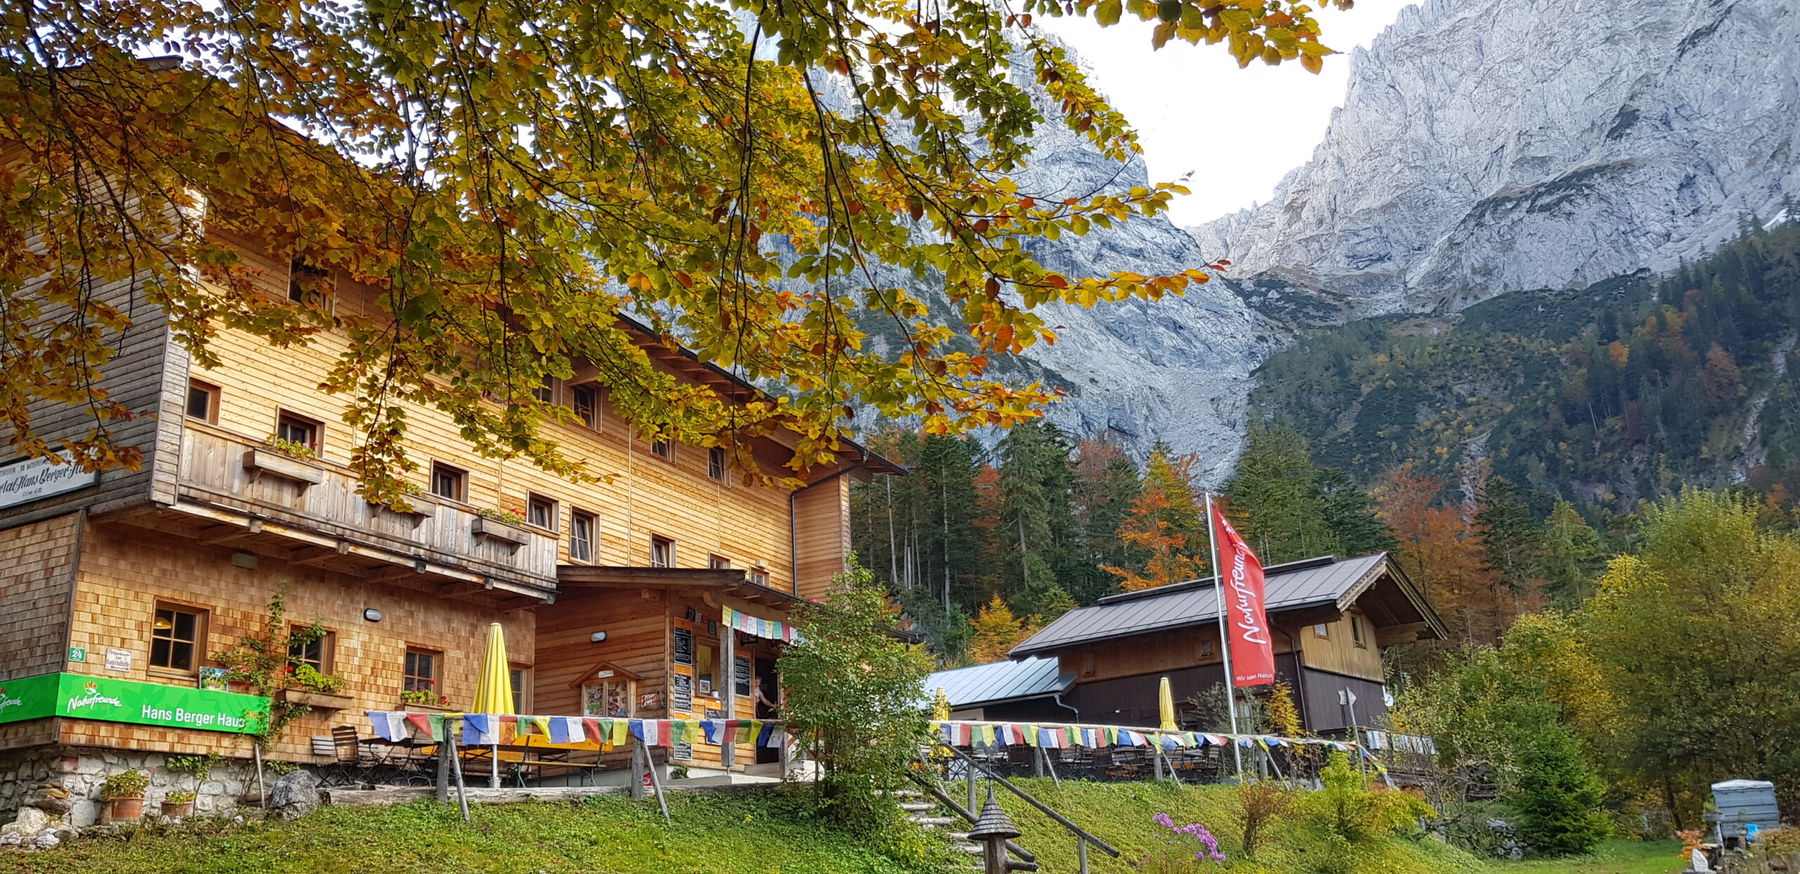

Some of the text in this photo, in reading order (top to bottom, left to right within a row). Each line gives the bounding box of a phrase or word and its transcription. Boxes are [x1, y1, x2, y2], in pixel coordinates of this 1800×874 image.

[1230, 541, 1267, 645] Naturfreund
[72, 649, 82, 659] 24
[66, 693, 122, 713] Naturfreunde
[141, 704, 172, 721] Hans
[175, 708, 215, 727] Berger
[217, 713, 246, 728] Haus
